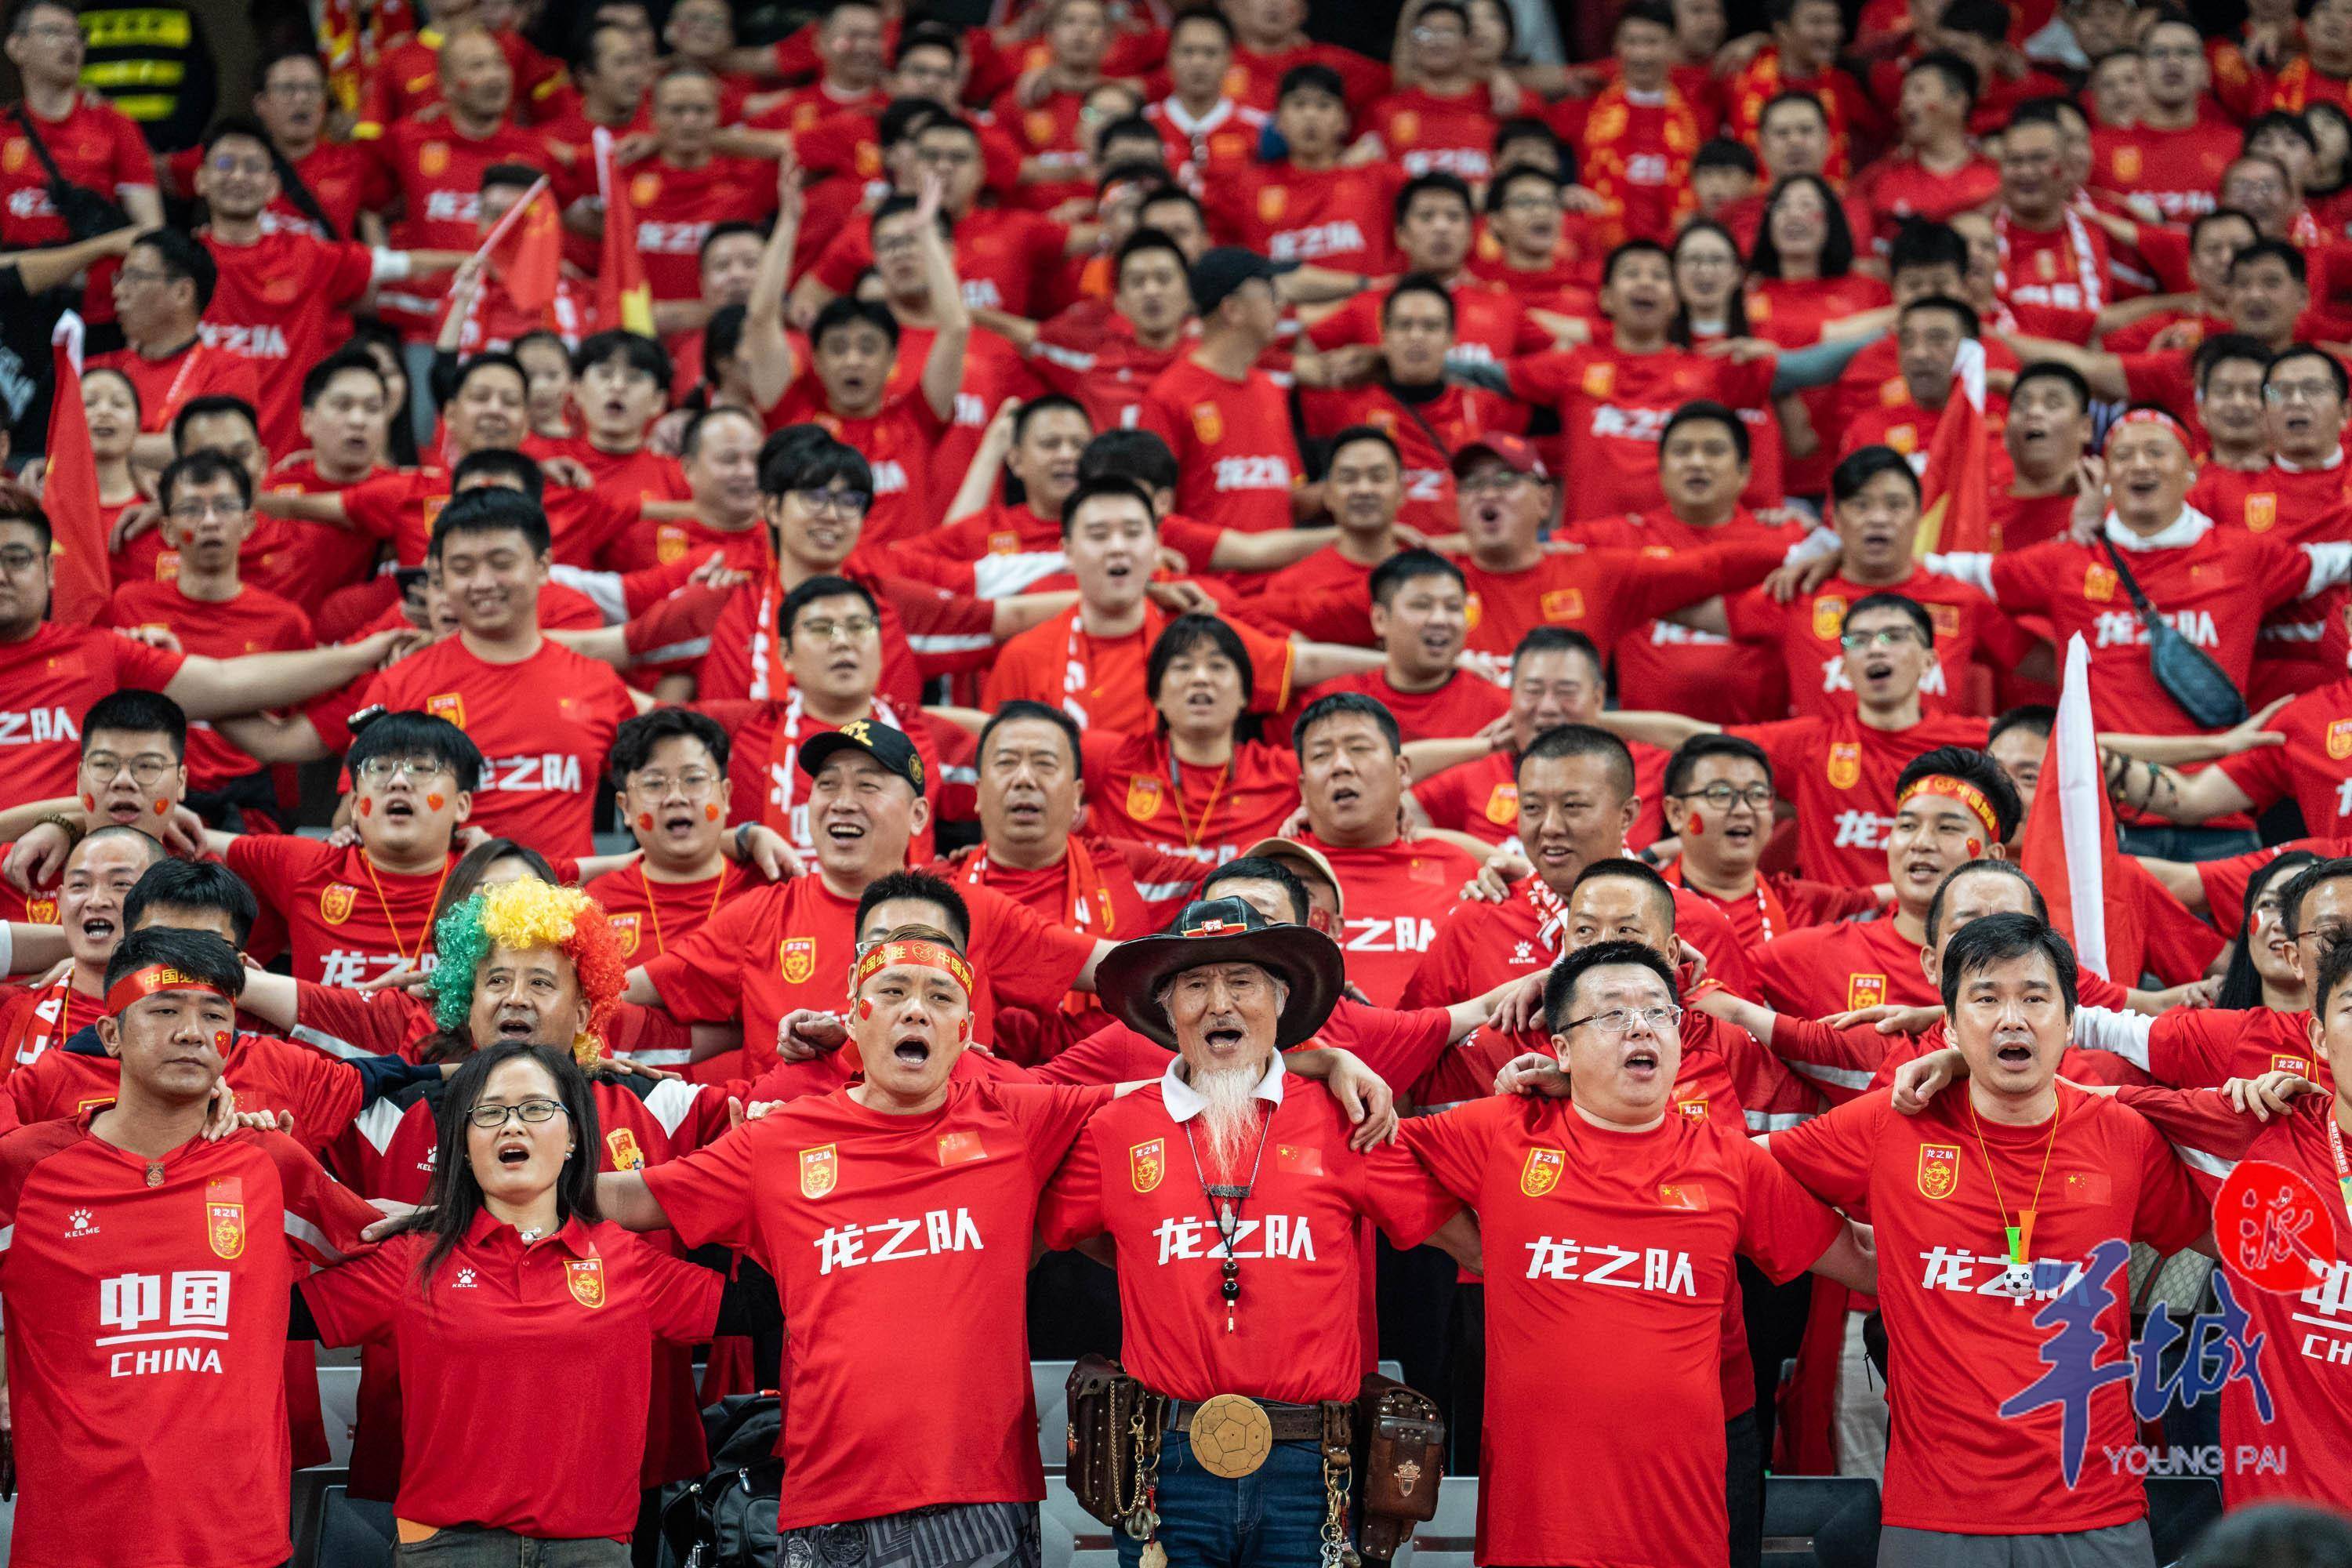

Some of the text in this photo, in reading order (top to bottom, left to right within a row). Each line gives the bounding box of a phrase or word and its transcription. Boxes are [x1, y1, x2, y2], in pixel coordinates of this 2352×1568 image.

[859, 946, 907, 979] 中国必胜
[2278, 1059, 2303, 1069] 龙之队
[1135, 1145, 1160, 1157] 龙之队
[1926, 1149, 1955, 1160] 龙之队
[805, 1152, 832, 1163] 龙之队
[1534, 1152, 1559, 1165] 龙之队
[213, 1207, 239, 1219] 龙之队
[64, 1227, 100, 1239] KELME
[814, 1207, 984, 1275] 龙之队
[1152, 1214, 1316, 1266] 龙之队
[573, 1261, 598, 1271] 龙之队
[1525, 1236, 1697, 1297] 龙之队
[100, 1271, 231, 1330] 中国
[111, 1348, 223, 1378] CHINA
